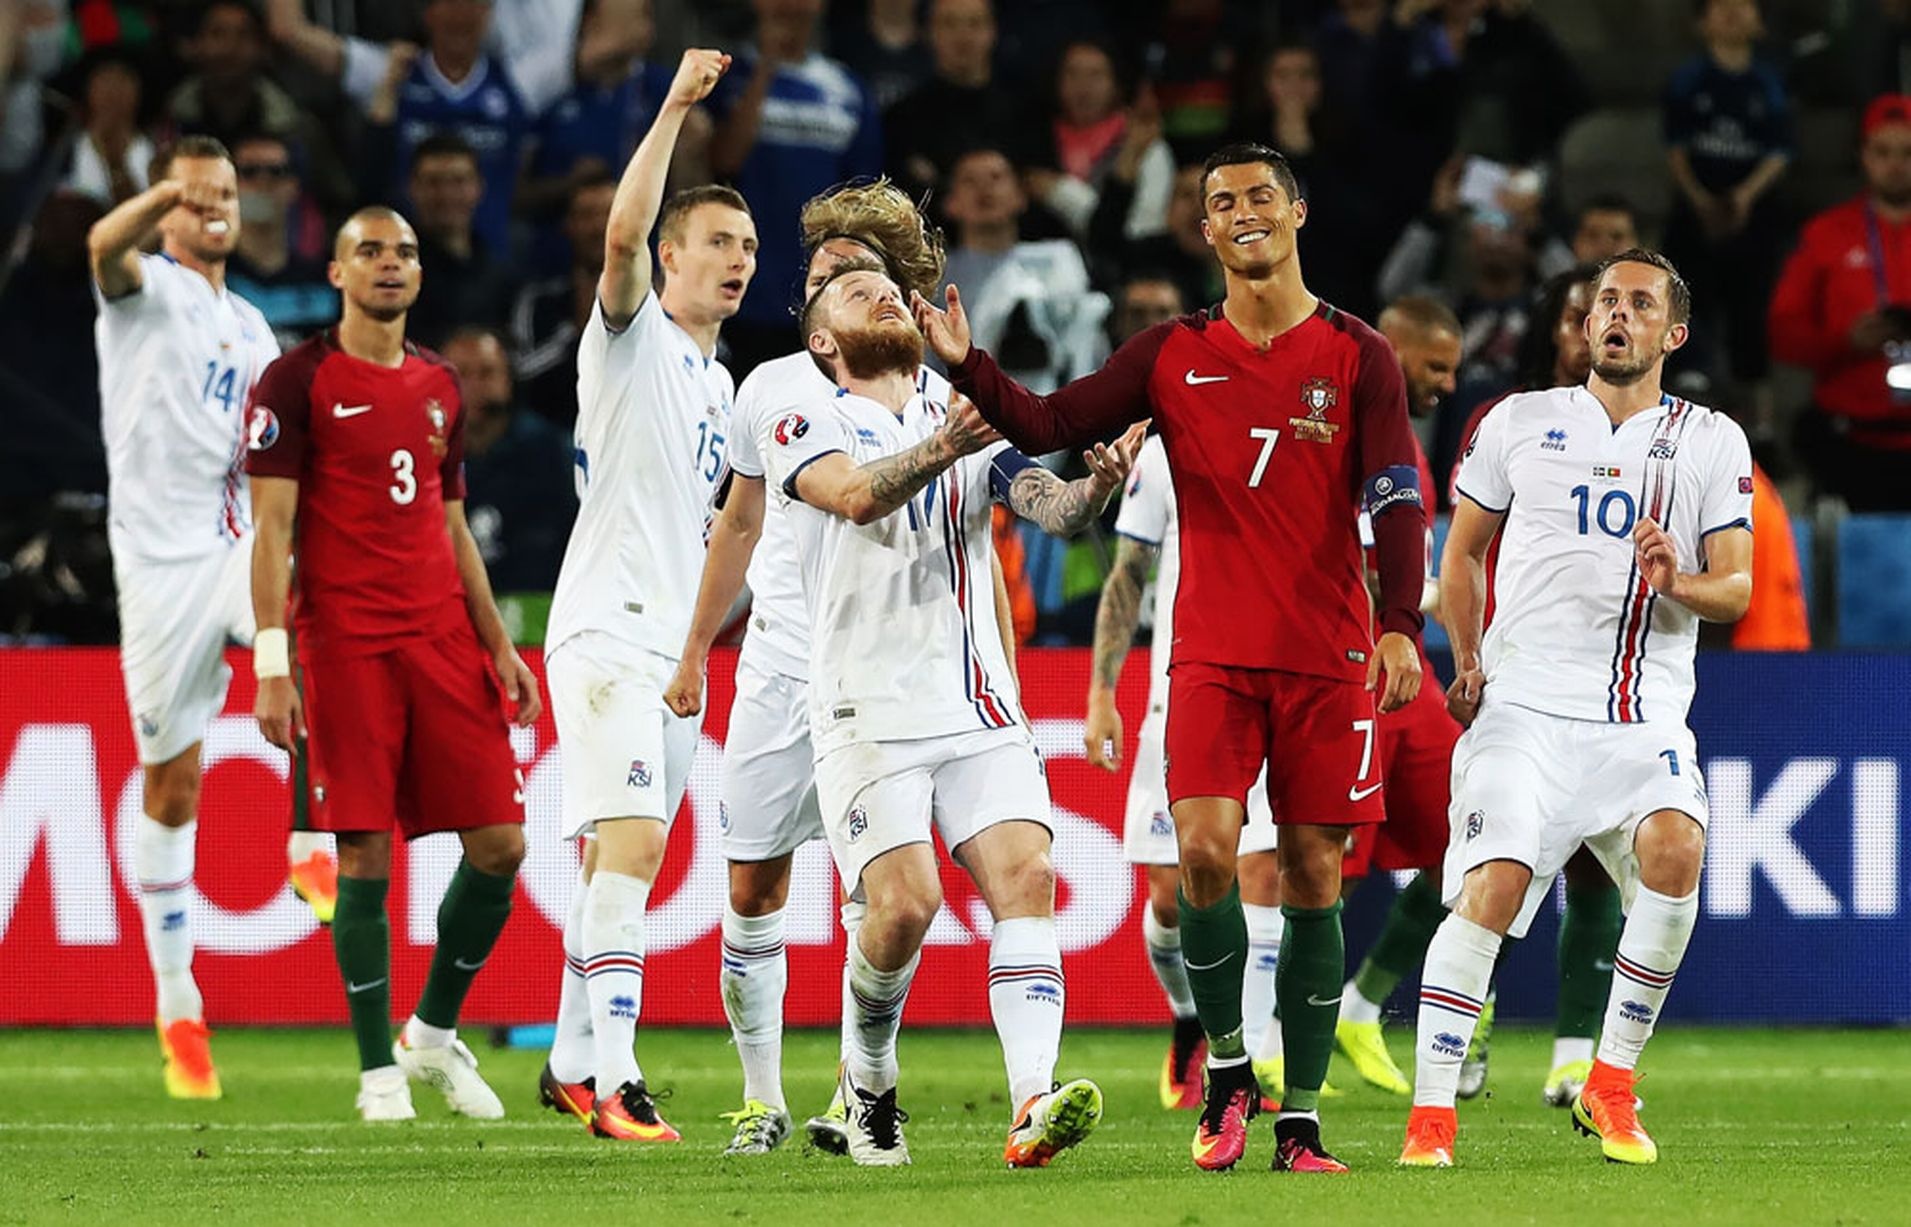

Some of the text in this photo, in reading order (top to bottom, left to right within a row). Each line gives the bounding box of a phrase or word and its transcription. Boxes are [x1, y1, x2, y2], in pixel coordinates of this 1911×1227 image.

[202, 360, 236, 412] 14
[389, 448, 417, 505] 3
[696, 421, 725, 482] 15
[1248, 427, 1281, 488] 7
[1570, 484, 1636, 539] 10
[1352, 719, 1375, 781] 7
